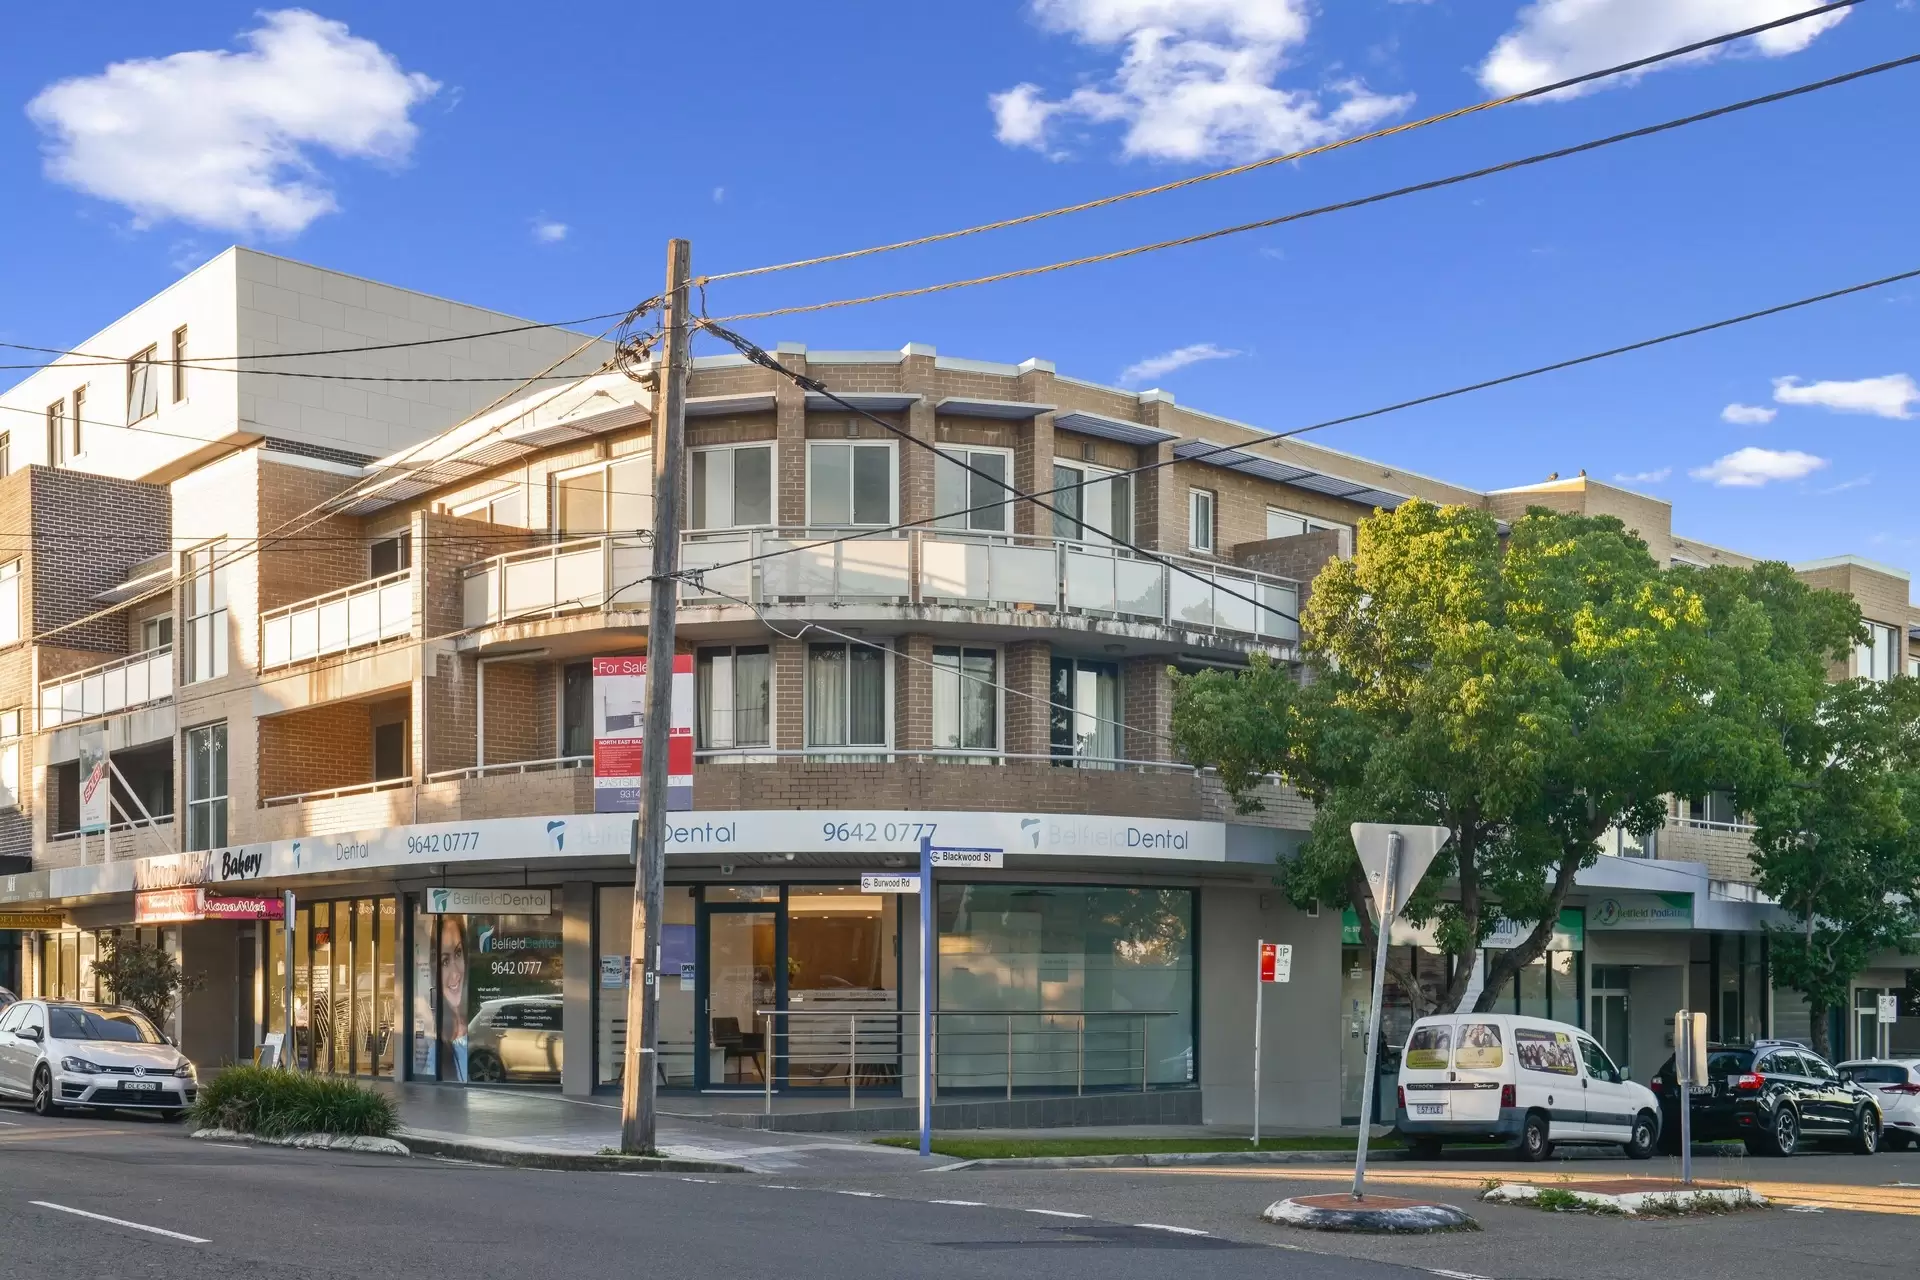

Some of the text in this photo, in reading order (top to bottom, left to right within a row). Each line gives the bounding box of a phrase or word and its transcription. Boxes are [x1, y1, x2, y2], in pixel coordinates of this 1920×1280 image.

[599, 661, 648, 674] For Sale
[84, 763, 103, 801] SOLD
[823, 823, 938, 842] 9642 0777
[407, 832, 480, 854] 9642 0777
[336, 841, 369, 861] Dental
[942, 851, 991, 862] Blackwood St
[222, 849, 262, 880] Bakery
[873, 878, 910, 888] Burwood Rd
[1280, 947, 1289, 957] 1P
[491, 961, 542, 974] 9642 0777
[681, 964, 694, 972] OPEN
[646, 974, 653, 983] H
